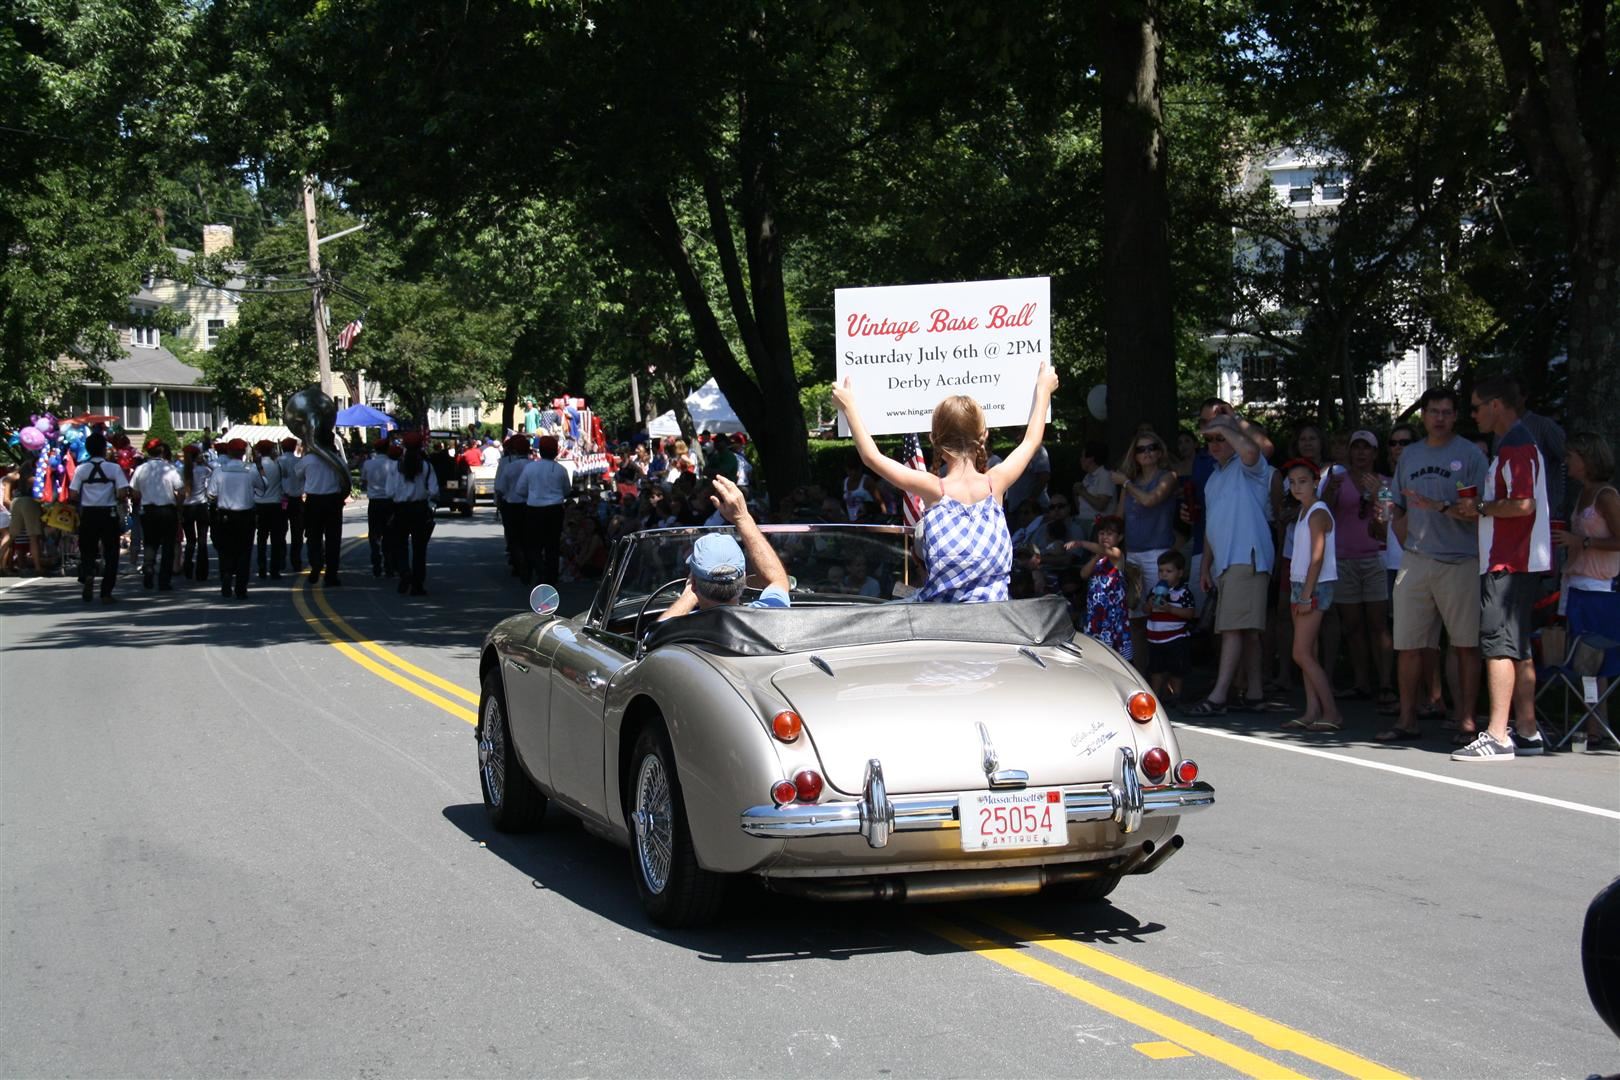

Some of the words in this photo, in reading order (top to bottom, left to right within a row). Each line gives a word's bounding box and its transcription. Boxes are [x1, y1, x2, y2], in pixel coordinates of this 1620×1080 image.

[847, 313, 920, 342] Vintage
[926, 308, 979, 333] Base
[985, 302, 1037, 329] Ball
[845, 349, 913, 366] Saturday
[917, 345, 948, 365] July
[952, 343, 978, 359] 6th
[984, 342, 1000, 359] @
[1006, 339, 1042, 356] 2PM
[888, 375, 931, 391] Derby
[936, 370, 1001, 388] Academy
[984, 794, 1041, 805] Massachusetts
[979, 805, 1053, 836] 25054
[993, 834, 1039, 844] ANTIQUE
